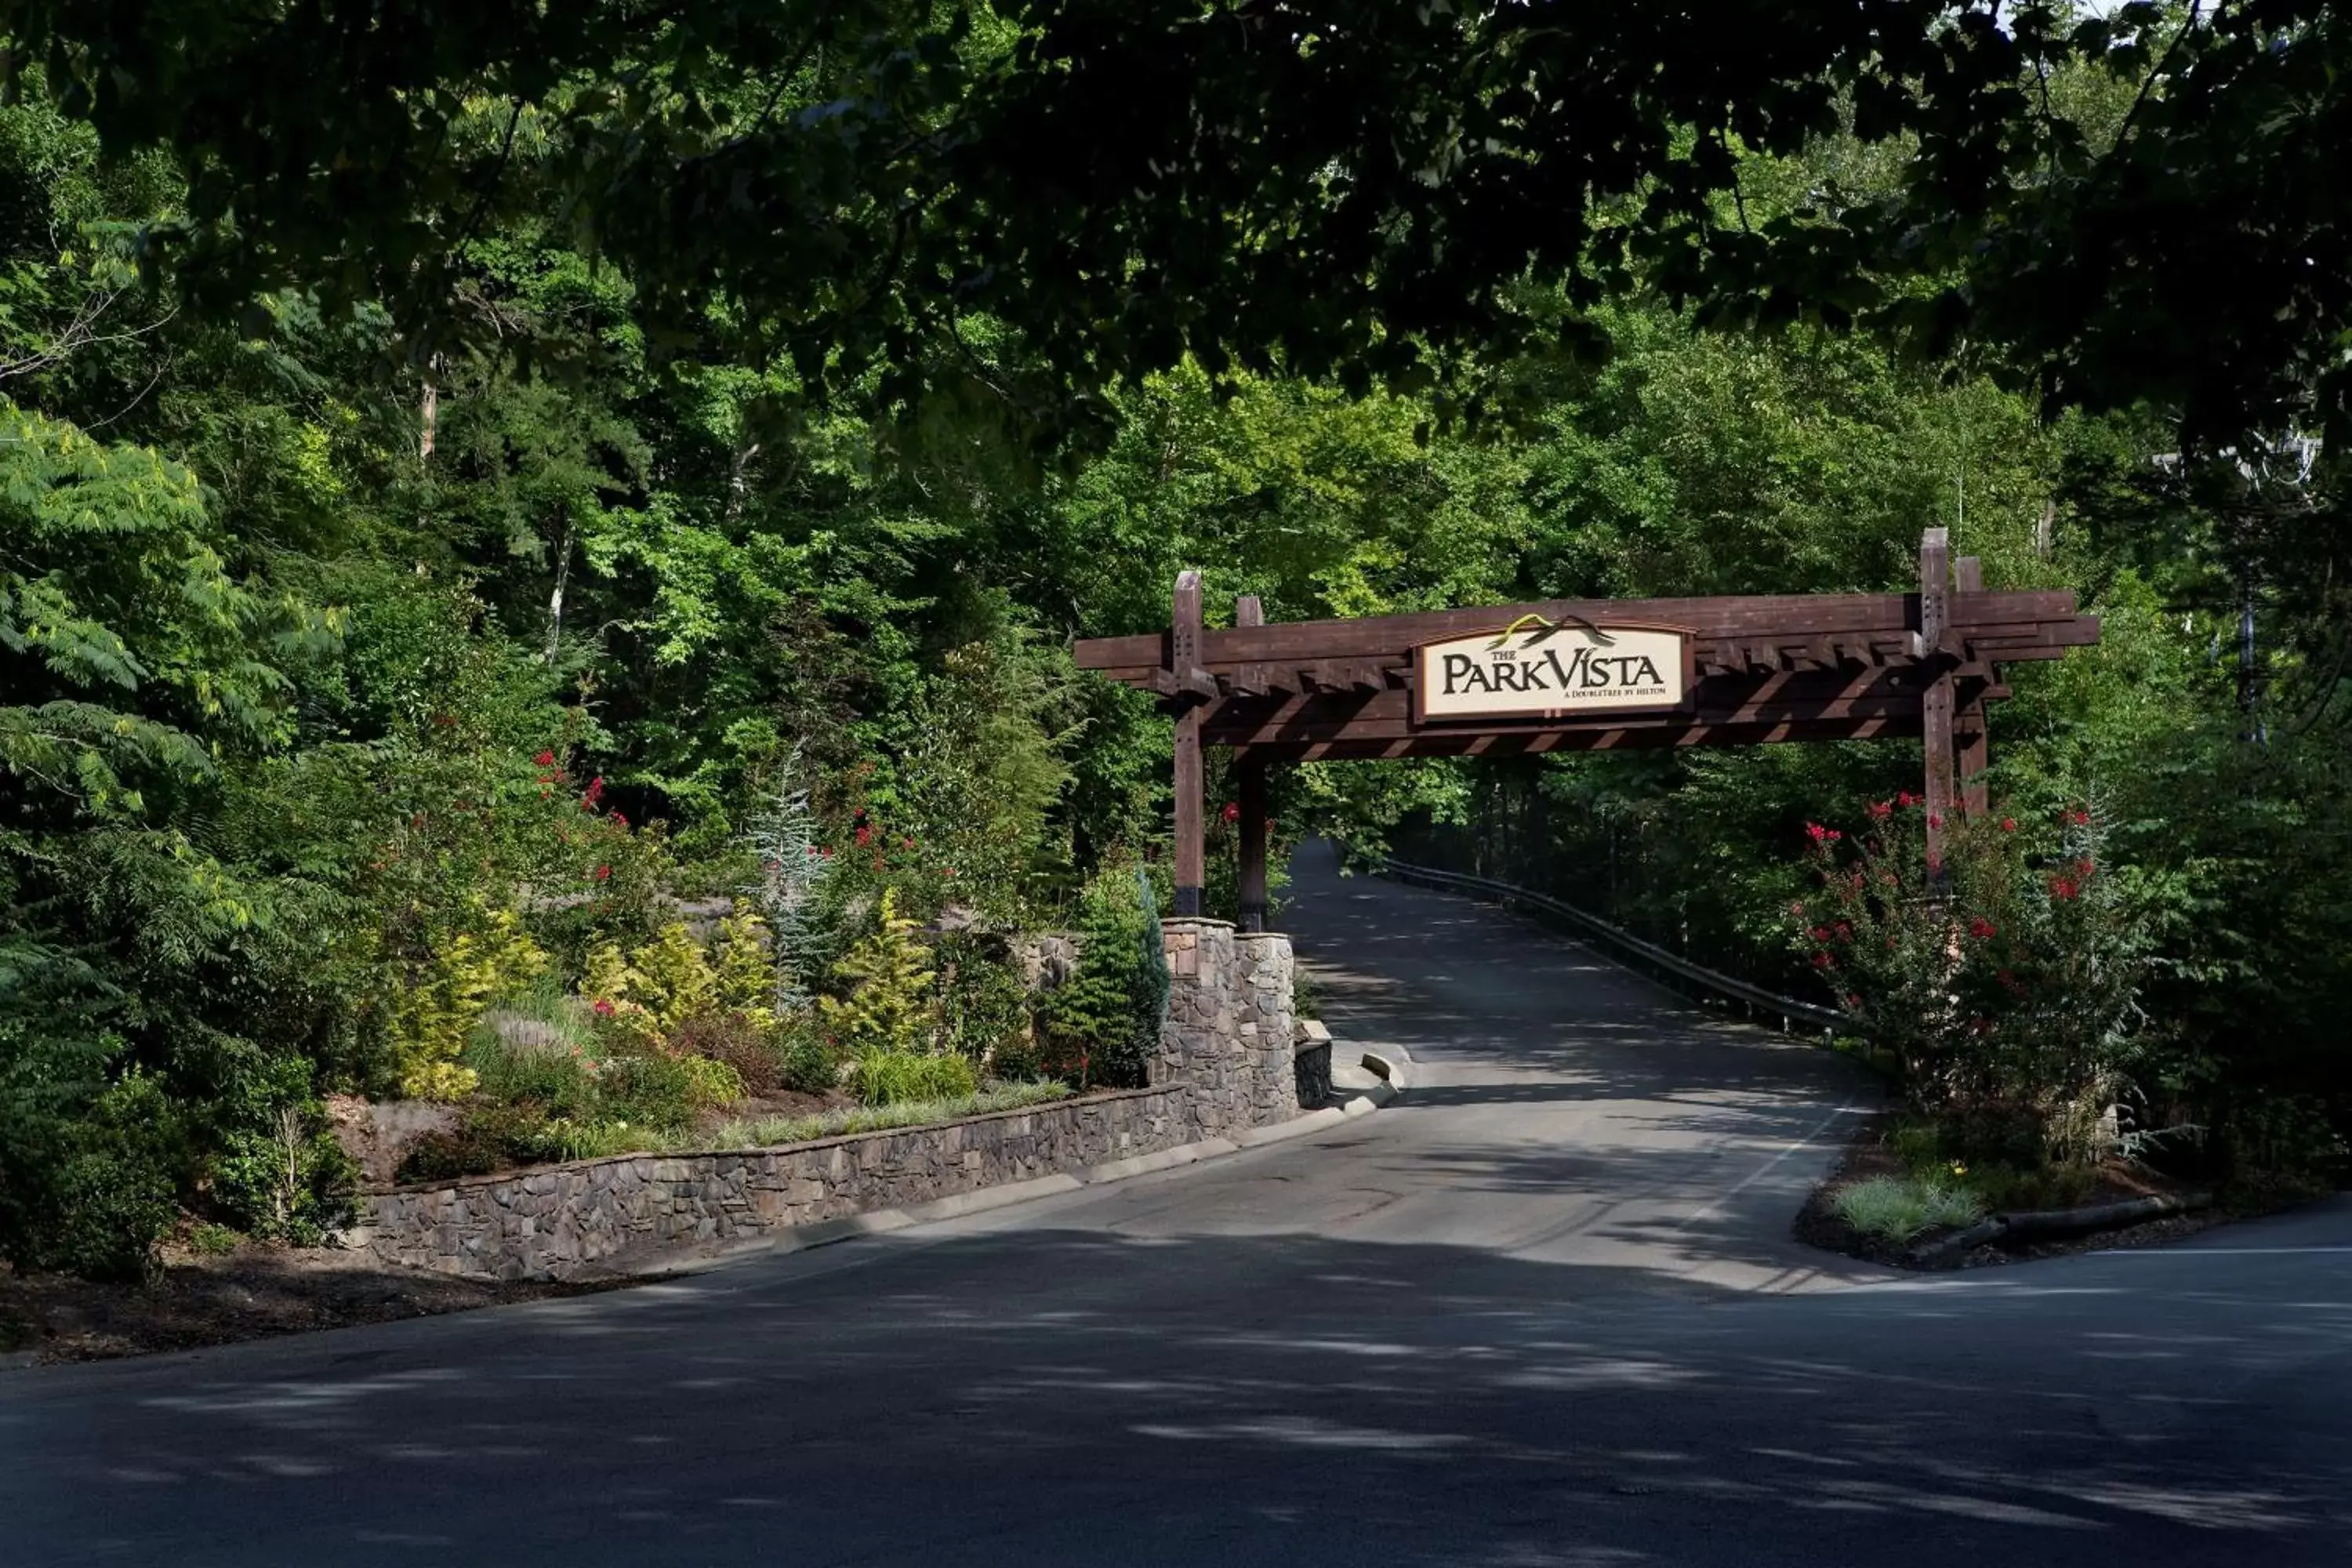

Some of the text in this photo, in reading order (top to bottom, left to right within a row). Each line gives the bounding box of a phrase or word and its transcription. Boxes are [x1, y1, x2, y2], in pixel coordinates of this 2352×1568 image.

[1491, 651, 1516, 661] THE
[1572, 689, 1621, 698] DOUBLETREE
[1636, 688, 1666, 696] HILTON
